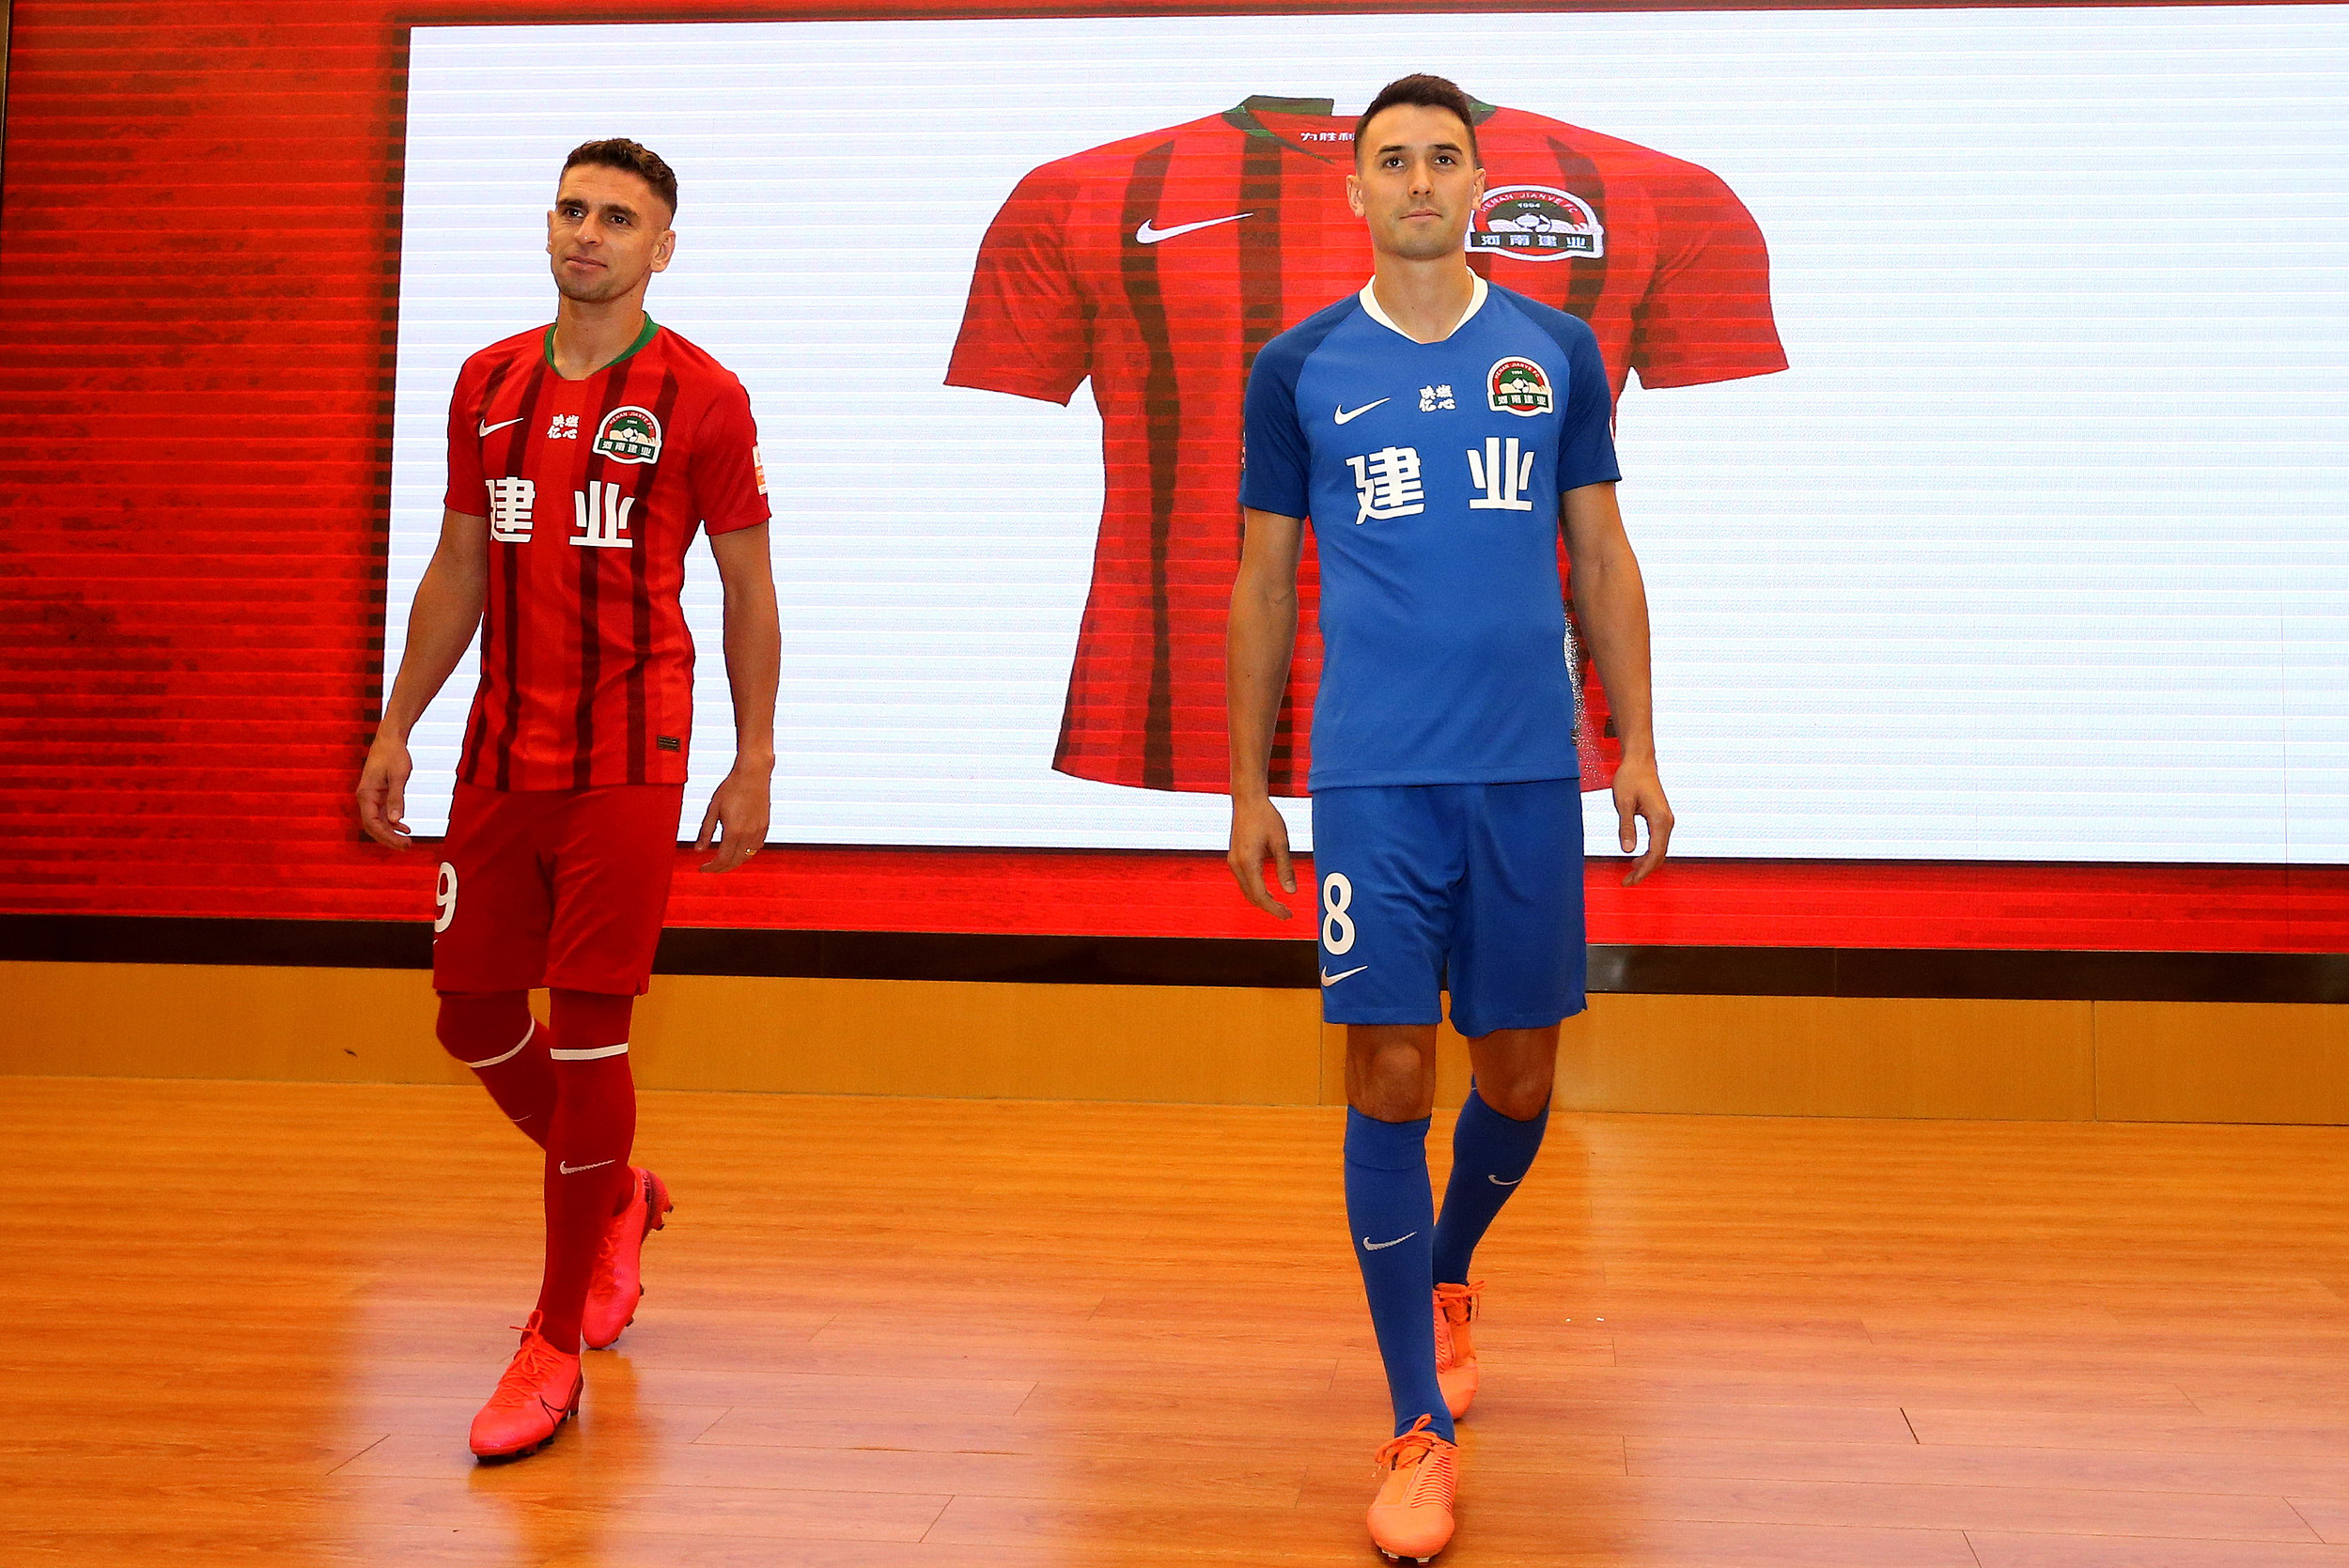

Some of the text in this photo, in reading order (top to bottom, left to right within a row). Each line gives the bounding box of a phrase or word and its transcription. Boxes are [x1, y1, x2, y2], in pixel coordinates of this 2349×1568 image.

[1519, 192, 1563, 206] JIANYE
[485, 476, 636, 549] 建业
[1346, 437, 1535, 525] 建业
[434, 862, 458, 933] 9
[1322, 872, 1356, 955] 8
